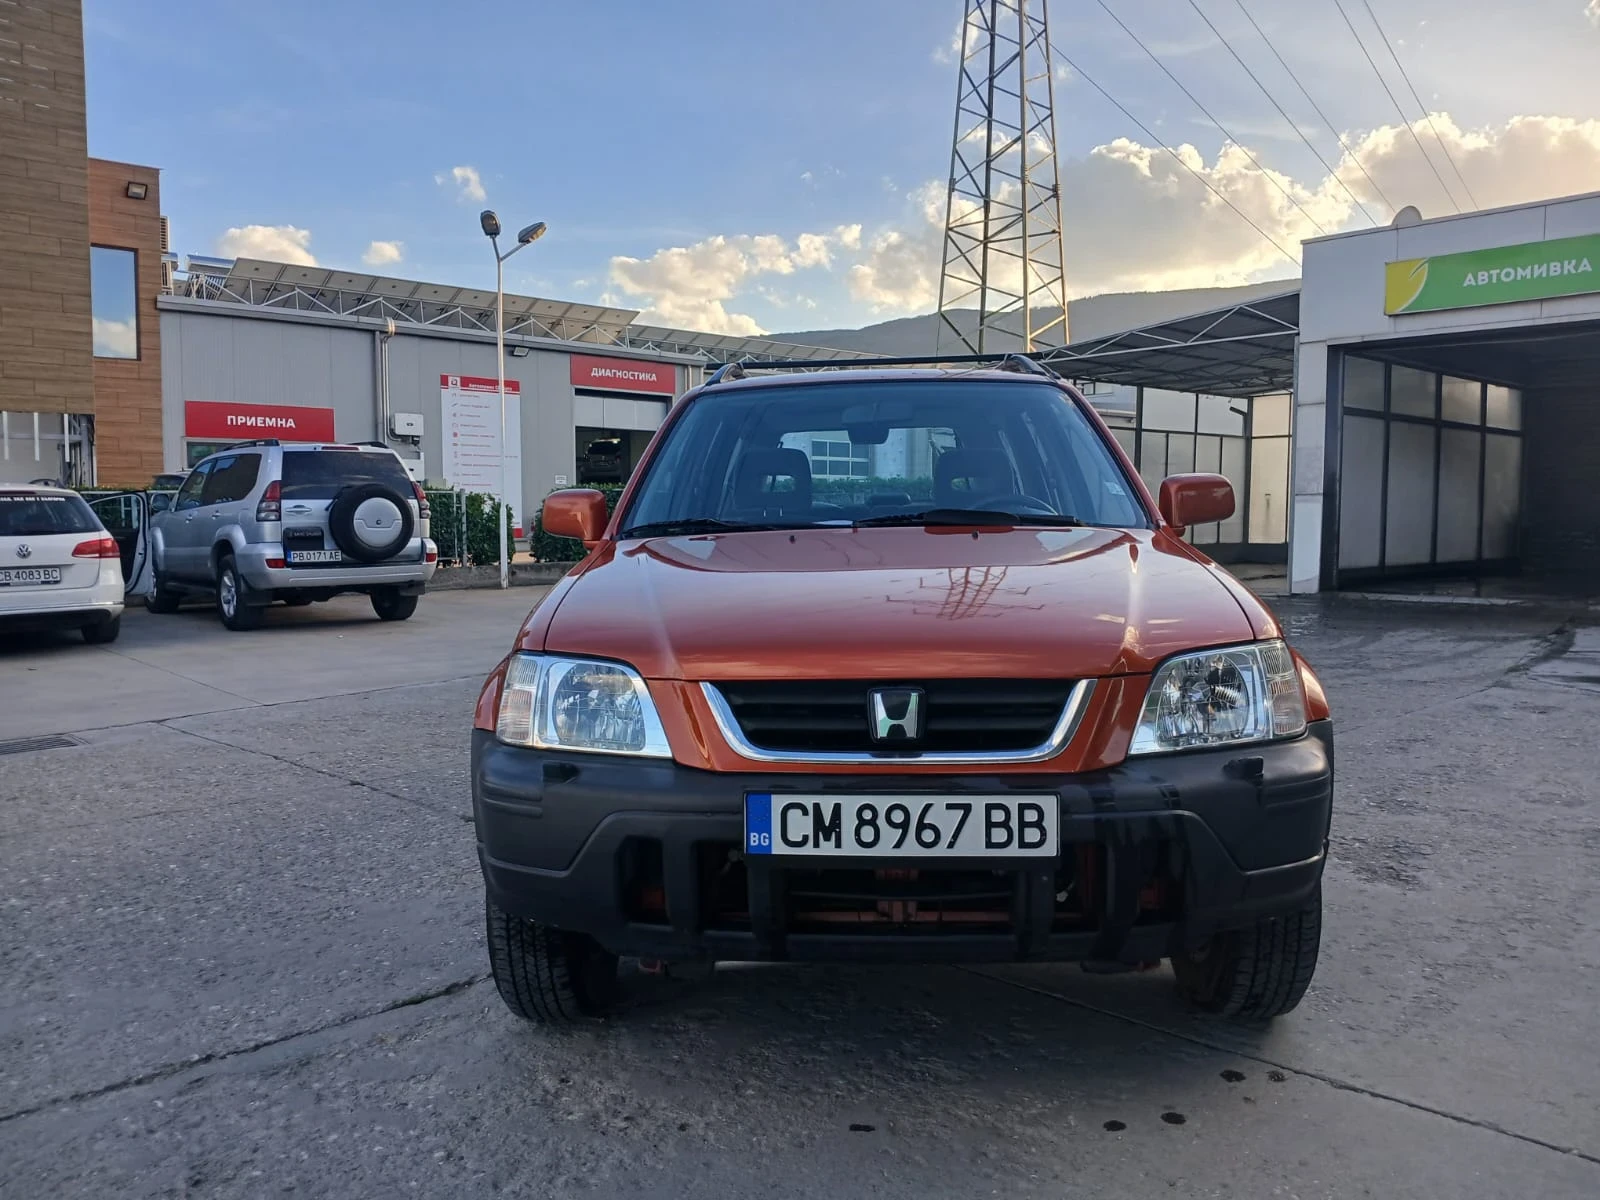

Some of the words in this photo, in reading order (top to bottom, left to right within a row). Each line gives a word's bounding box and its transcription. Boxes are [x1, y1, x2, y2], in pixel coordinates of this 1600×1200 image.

[1463, 257, 1593, 287] АВТОМИВКА
[591, 367, 657, 382] ДИАГНОСТИКА
[227, 415, 296, 429] ПРИЕМНА
[306, 551, 327, 561] 0171
[329, 551, 340, 560] AE
[14, 570, 42, 580] 4083
[43, 569, 58, 579] BC
[780, 801, 842, 849] CM
[854, 802, 973, 849] 8967
[984, 802, 1048, 849] BB
[750, 832, 769, 847] BG
